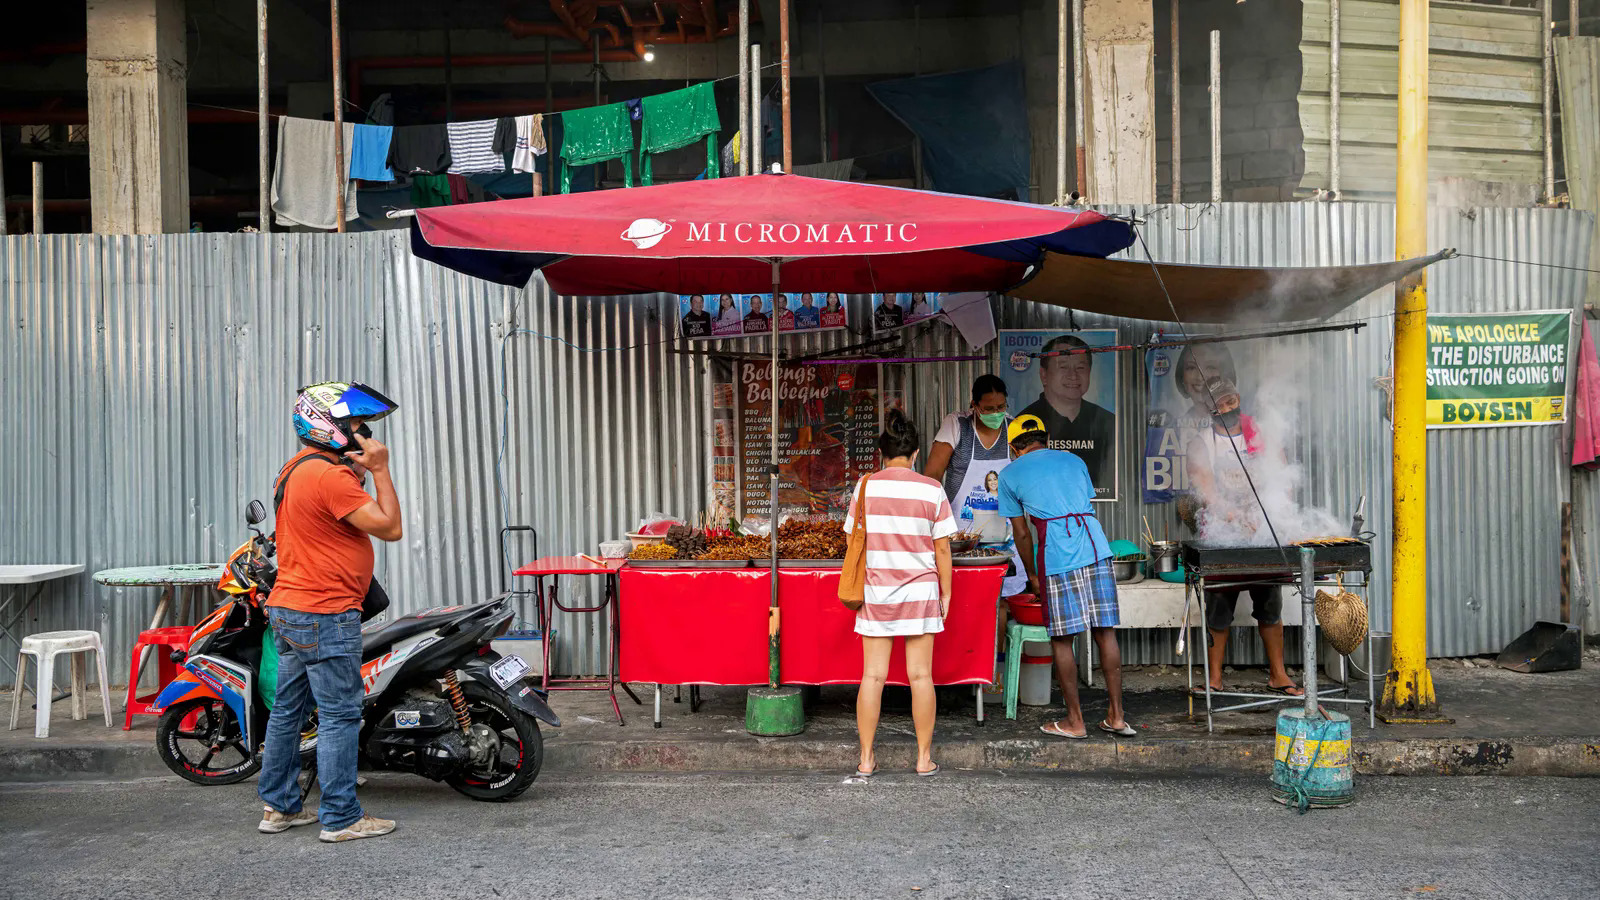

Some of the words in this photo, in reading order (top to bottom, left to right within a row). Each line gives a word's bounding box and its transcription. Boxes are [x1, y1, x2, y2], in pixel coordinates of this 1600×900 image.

[686, 222, 918, 243] MICROMATIC
[1005, 336, 1042, 347] IBOTO!
[1428, 325, 1453, 343] WE
[1456, 323, 1541, 343] APOLOGIZE
[1432, 347, 1463, 366] THE
[1468, 344, 1565, 365] DISTURBANCE
[1427, 367, 1503, 387] STRUCTION
[1506, 365, 1549, 384] GOING
[746, 381, 829, 404] Babeque
[1442, 401, 1533, 422] BOYSEN
[785, 448, 822, 456] BULAKLAK
[489, 772, 517, 790] YAMAHA
